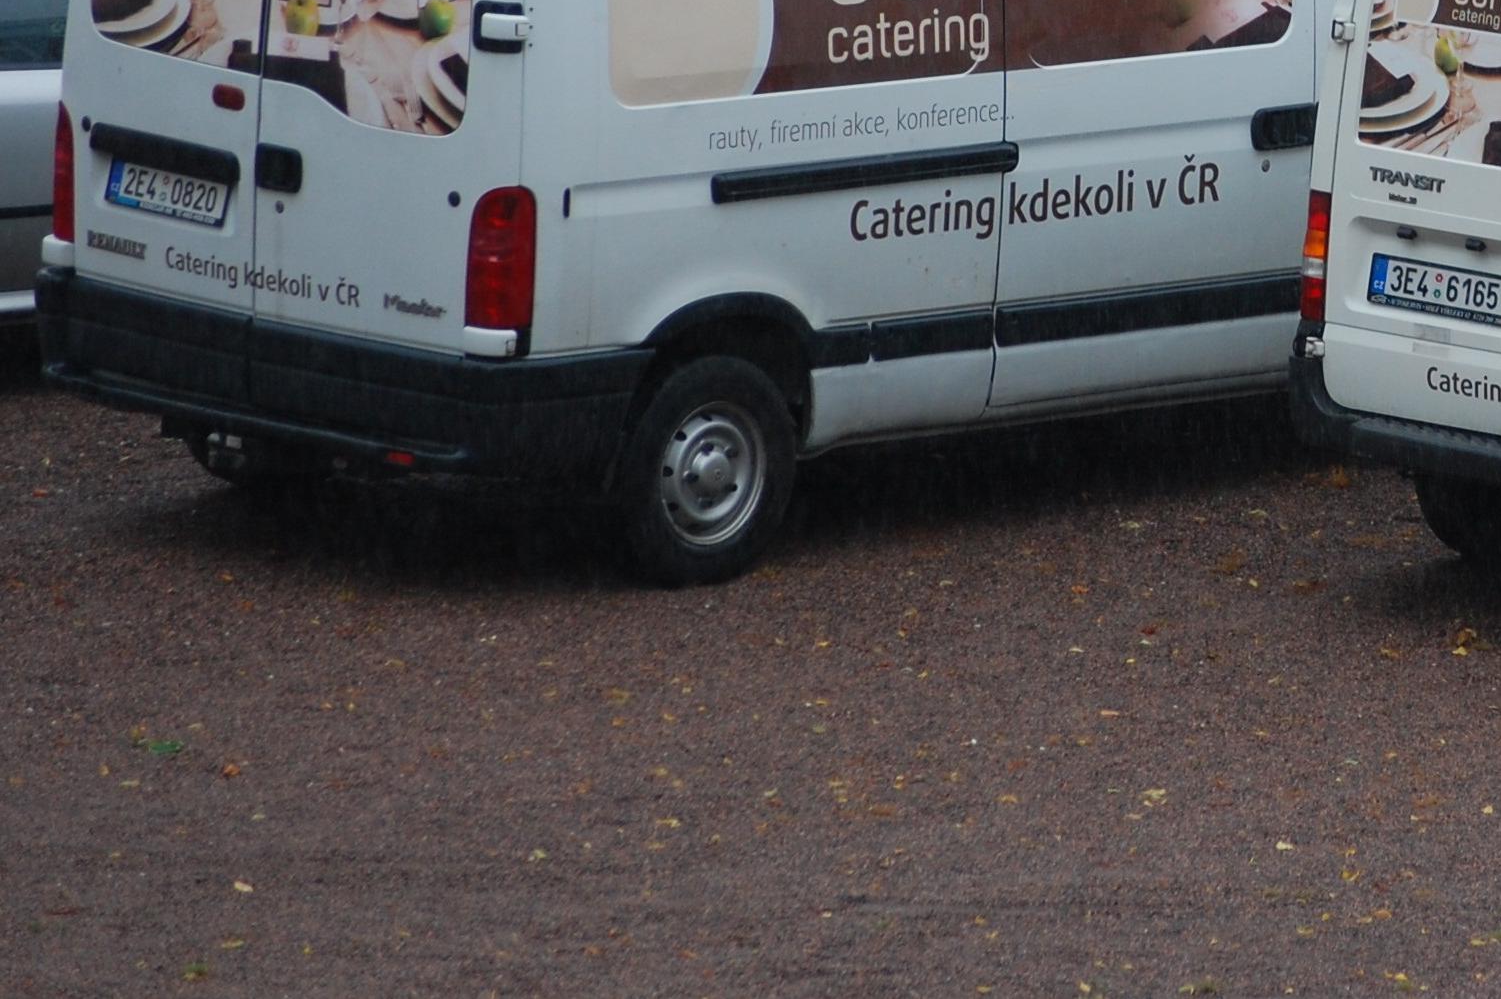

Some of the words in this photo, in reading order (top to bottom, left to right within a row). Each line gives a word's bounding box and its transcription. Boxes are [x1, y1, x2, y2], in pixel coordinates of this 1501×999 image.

[827, 8, 990, 64] catering
[1452, 6, 1501, 31] catering
[708, 117, 764, 153] rauty,
[770, 111, 838, 145] firemní
[842, 113, 890, 139] akce,
[123, 167, 157, 200] 2E4
[170, 177, 218, 214] 0820
[850, 189, 996, 241] Catering
[1008, 169, 1135, 225] kdekoli
[1147, 176, 1168, 208] v
[1178, 153, 1221, 205] ČR
[1369, 166, 1446, 193] TRANSIT
[165, 246, 239, 290] Catering
[244, 260, 311, 299] kdekoli
[317, 285, 330, 302] v
[335, 276, 361, 308] ČR
[1373, 280, 1385, 290] CZ
[1390, 265, 1429, 298] 3E4
[1446, 275, 1501, 310] 6165
